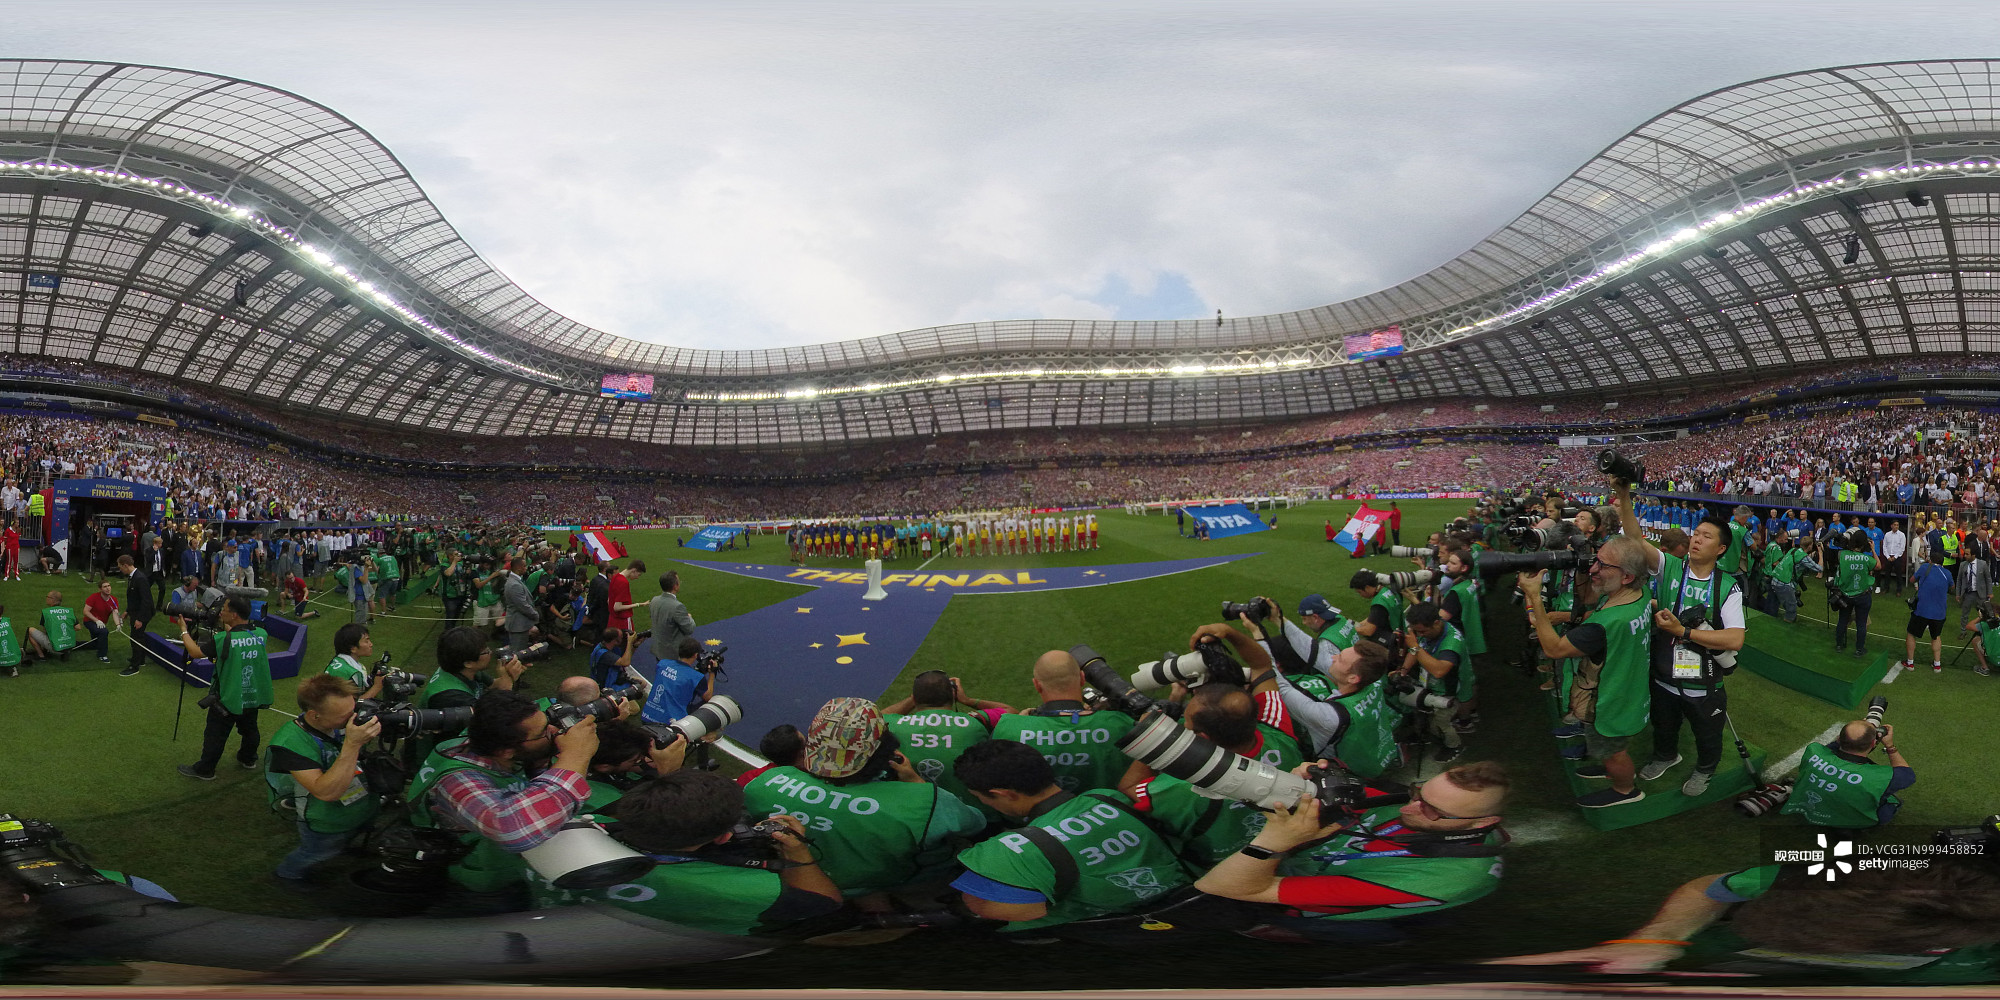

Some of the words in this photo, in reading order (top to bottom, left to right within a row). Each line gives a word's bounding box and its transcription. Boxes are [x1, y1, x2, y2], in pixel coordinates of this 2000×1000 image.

[91, 488, 117, 498] FINAL
[116, 490, 133, 499] 2018
[1201, 514, 1252, 529] FIFA
[1844, 554, 1870, 562] PHOTO
[1850, 563, 1864, 571] 023
[786, 569, 868, 585] THE
[881, 572, 1047, 587] FINAL
[231, 636, 264, 648] PHOTO
[241, 650, 258, 660] 149
[661, 669, 678, 681] FILMS
[665, 666, 678, 676] FIFA
[897, 713, 970, 728] PHOTO
[910, 733, 952, 749] 531
[1019, 728, 1110, 746] PHOTO
[1808, 754, 1863, 785] PHOTO
[1808, 773, 1838, 793] 519
[764, 773, 880, 816] PHOTO
[1079, 829, 1141, 866] 300
